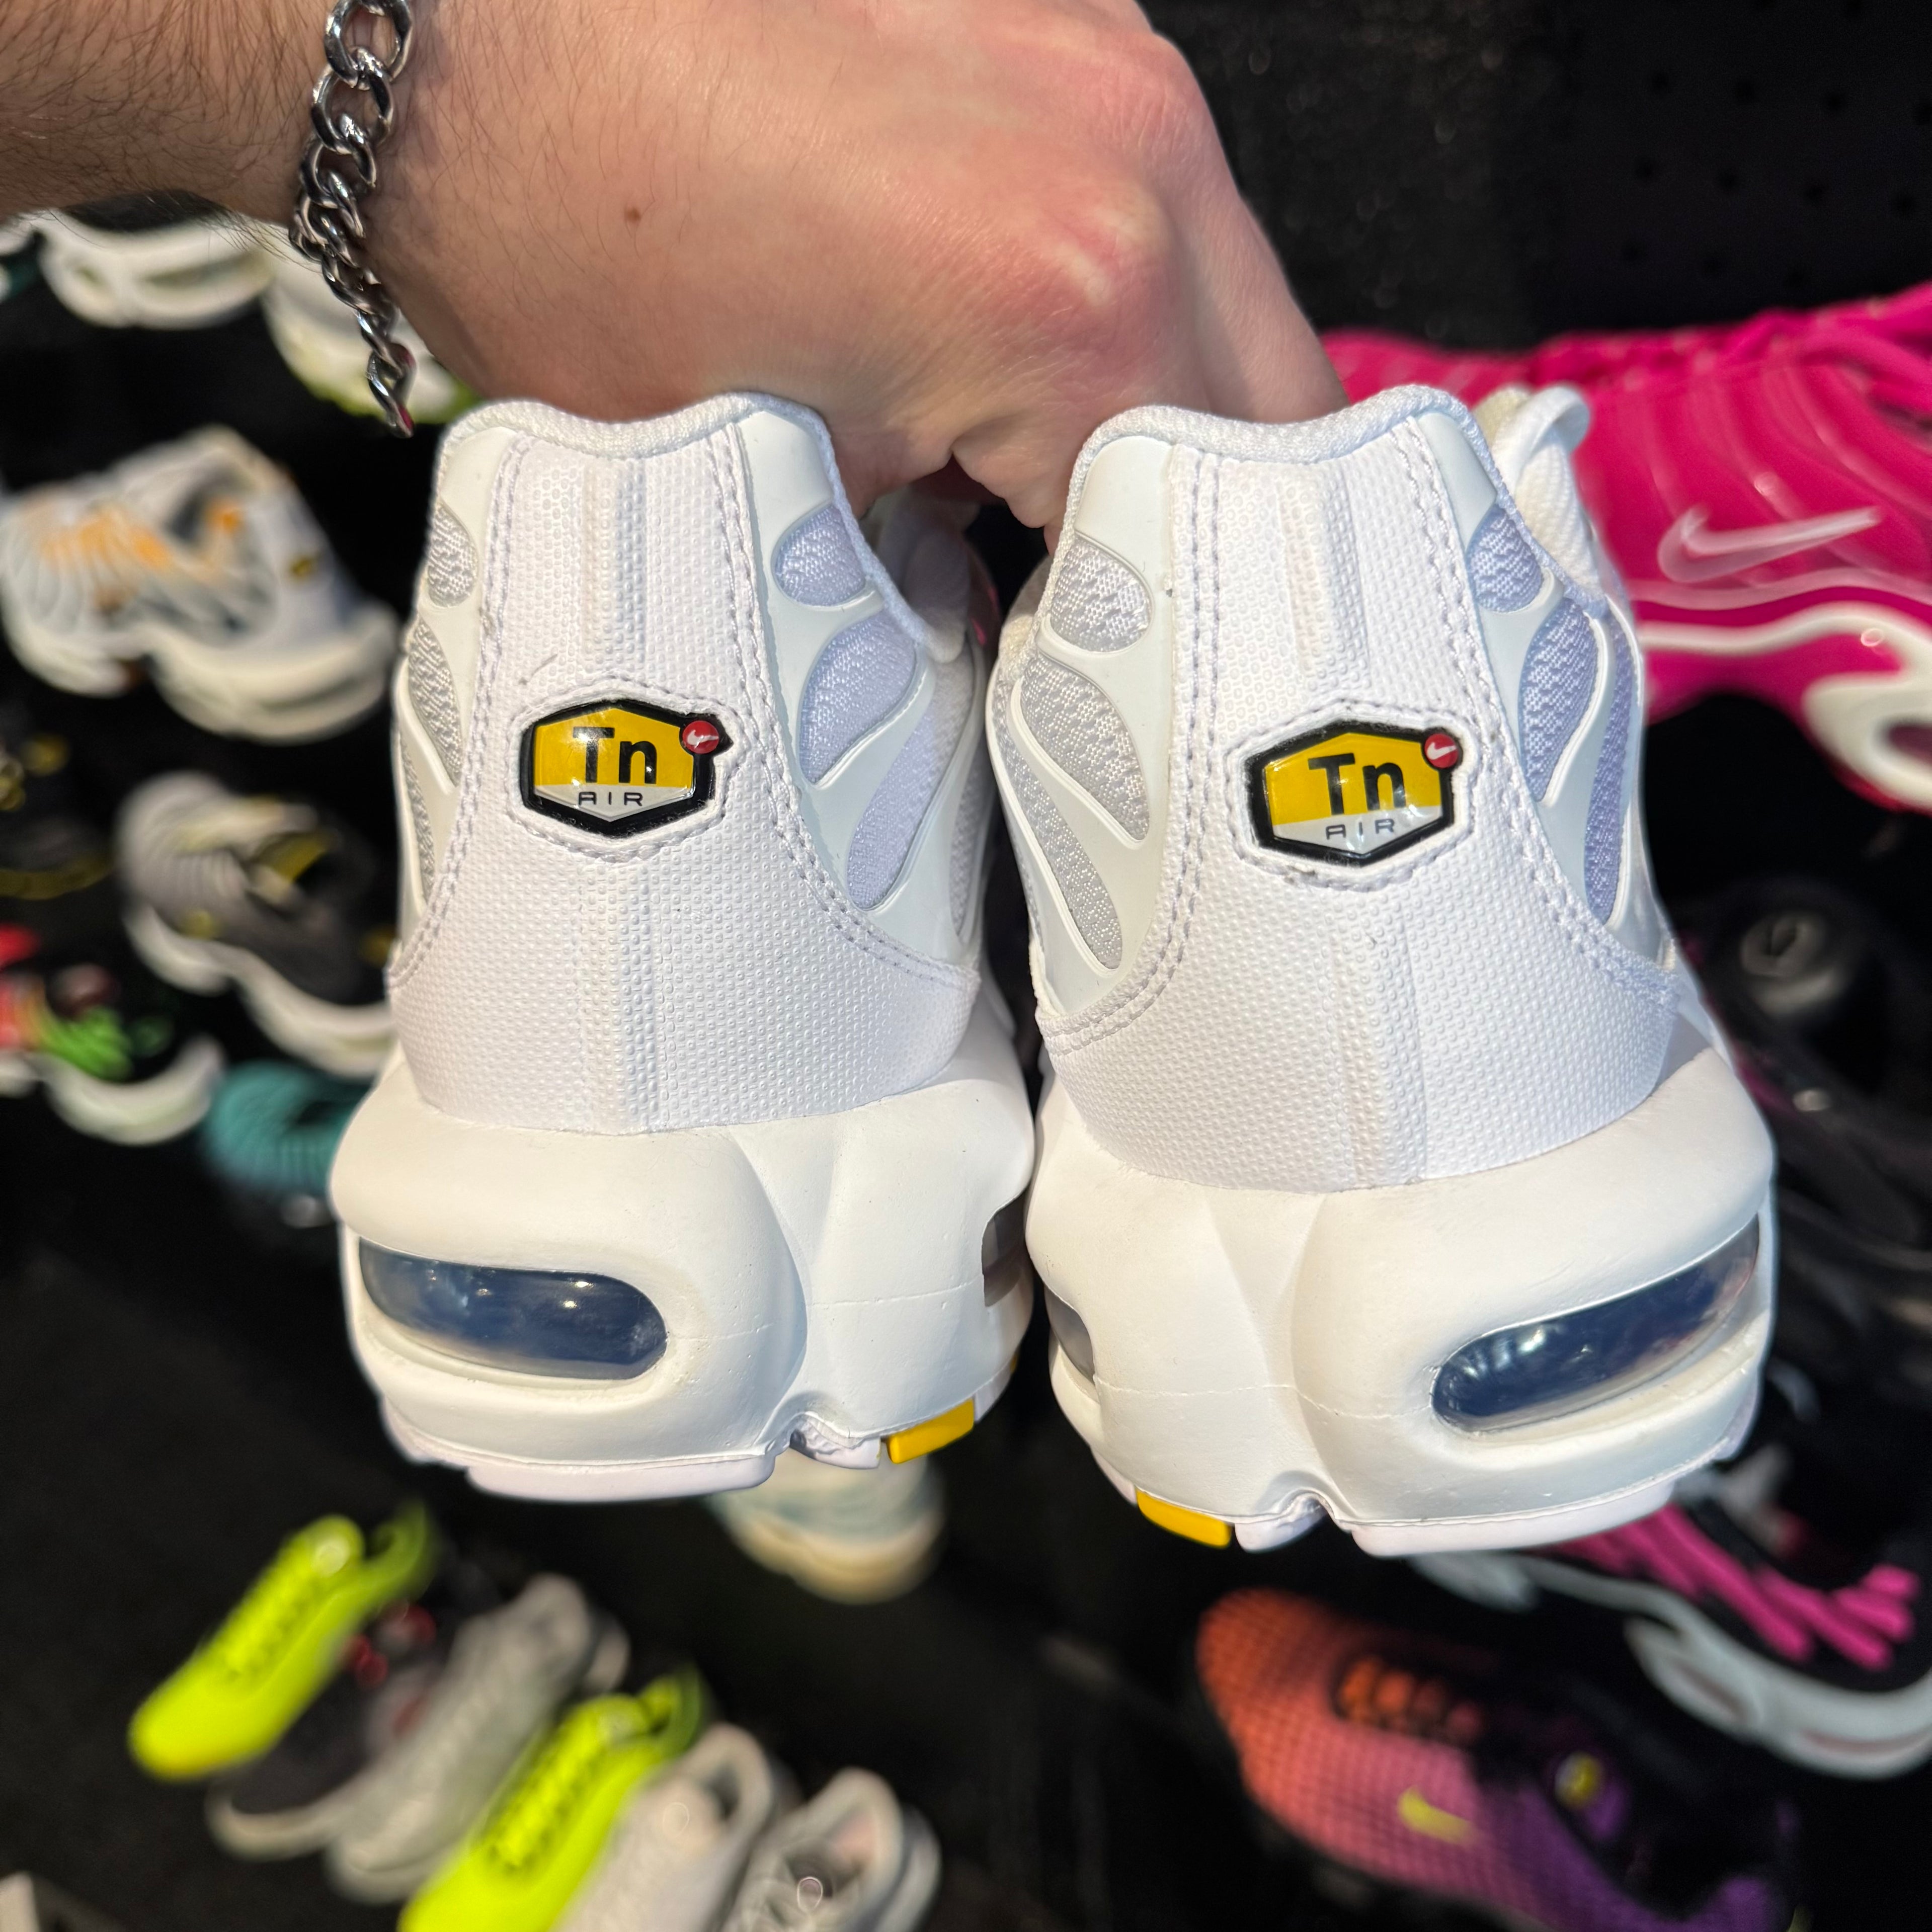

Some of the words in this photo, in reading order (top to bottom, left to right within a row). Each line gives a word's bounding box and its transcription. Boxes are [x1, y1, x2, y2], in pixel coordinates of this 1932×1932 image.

[573, 727, 657, 784] Tn
[578, 791, 643, 807] AIR
[1308, 753, 1406, 815] Tn
[1325, 818, 1395, 840] AIR
